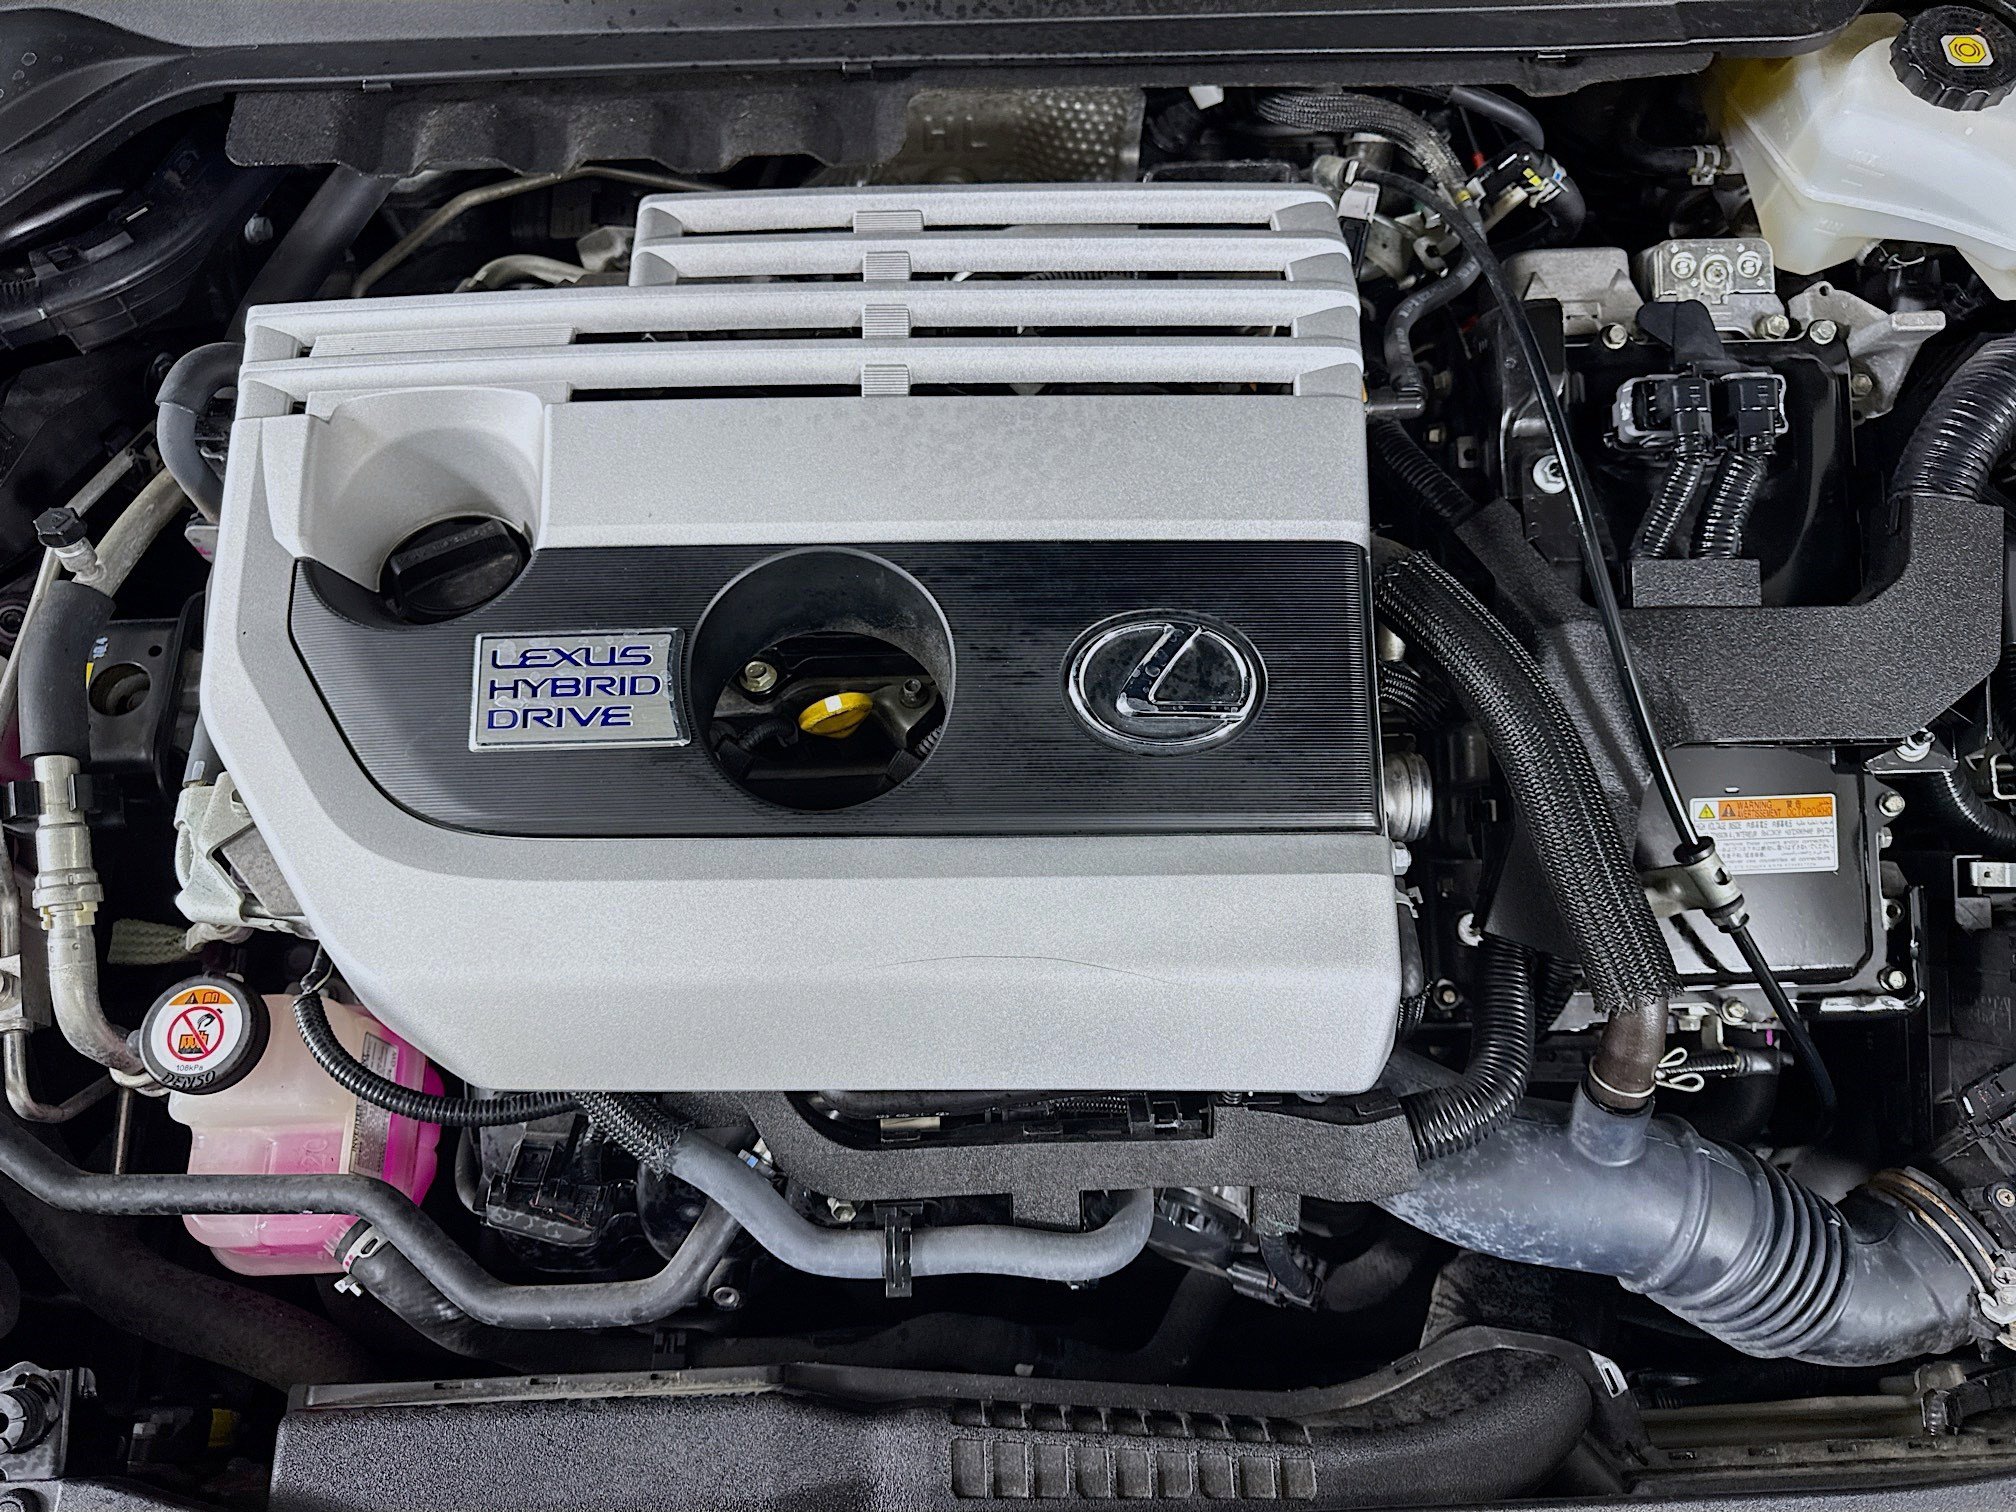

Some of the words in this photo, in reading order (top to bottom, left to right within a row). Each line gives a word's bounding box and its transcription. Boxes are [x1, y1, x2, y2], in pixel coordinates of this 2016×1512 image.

[491, 645, 653, 669] LEXUS
[489, 675, 662, 699] HYBRID
[487, 705, 634, 729] DRIVE
[1737, 800, 1772, 809] WARNING
[161, 1070, 216, 1089] DENSO
